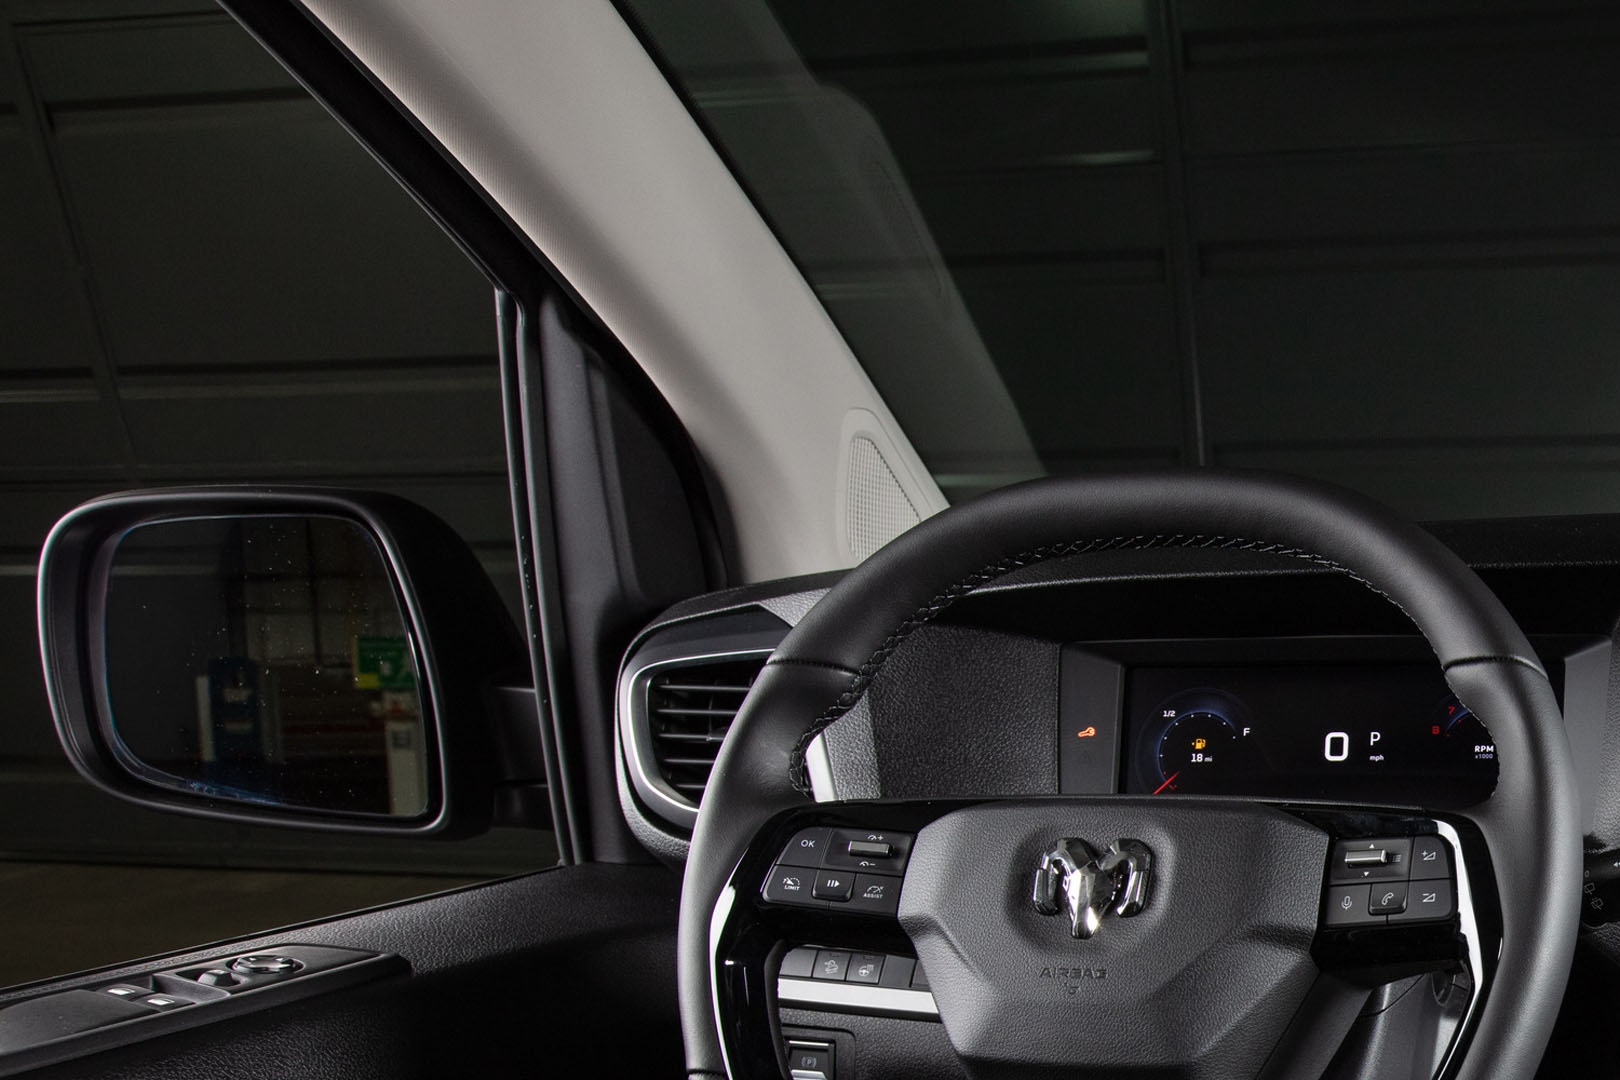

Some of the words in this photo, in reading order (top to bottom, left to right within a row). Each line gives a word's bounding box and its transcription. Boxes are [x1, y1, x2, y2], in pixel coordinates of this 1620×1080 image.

[1448, 706, 1456, 715] 7
[1243, 727, 1250, 737] F
[1370, 731, 1381, 746] P
[1325, 731, 1349, 762] 0
[1474, 745, 1494, 753] RPM
[1191, 753, 1203, 763] 18
[1369, 754, 1384, 762] mph
[801, 839, 816, 848] OK
